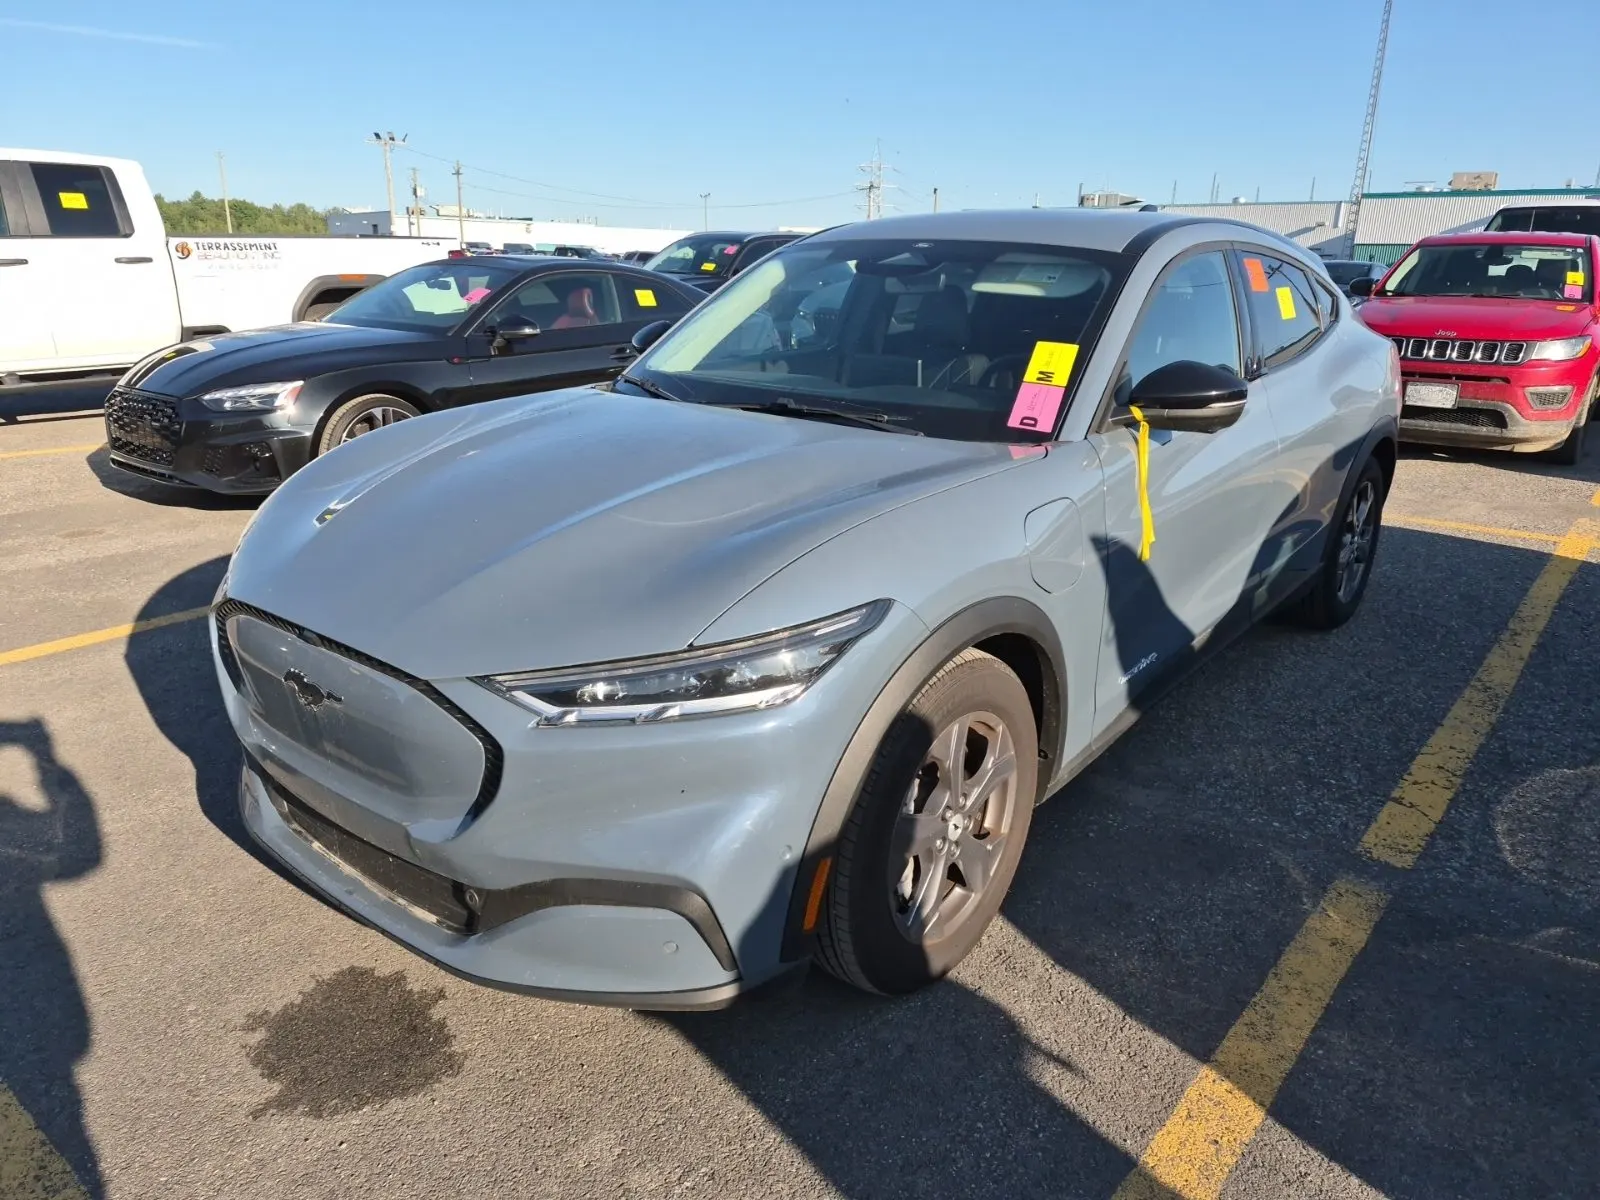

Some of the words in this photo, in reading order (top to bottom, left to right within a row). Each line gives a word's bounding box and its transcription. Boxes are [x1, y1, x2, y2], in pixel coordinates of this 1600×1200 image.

[194, 242, 278, 251] TERRASSEMENT
[1036, 370, 1055, 383] M
[1019, 416, 1038, 428] D
